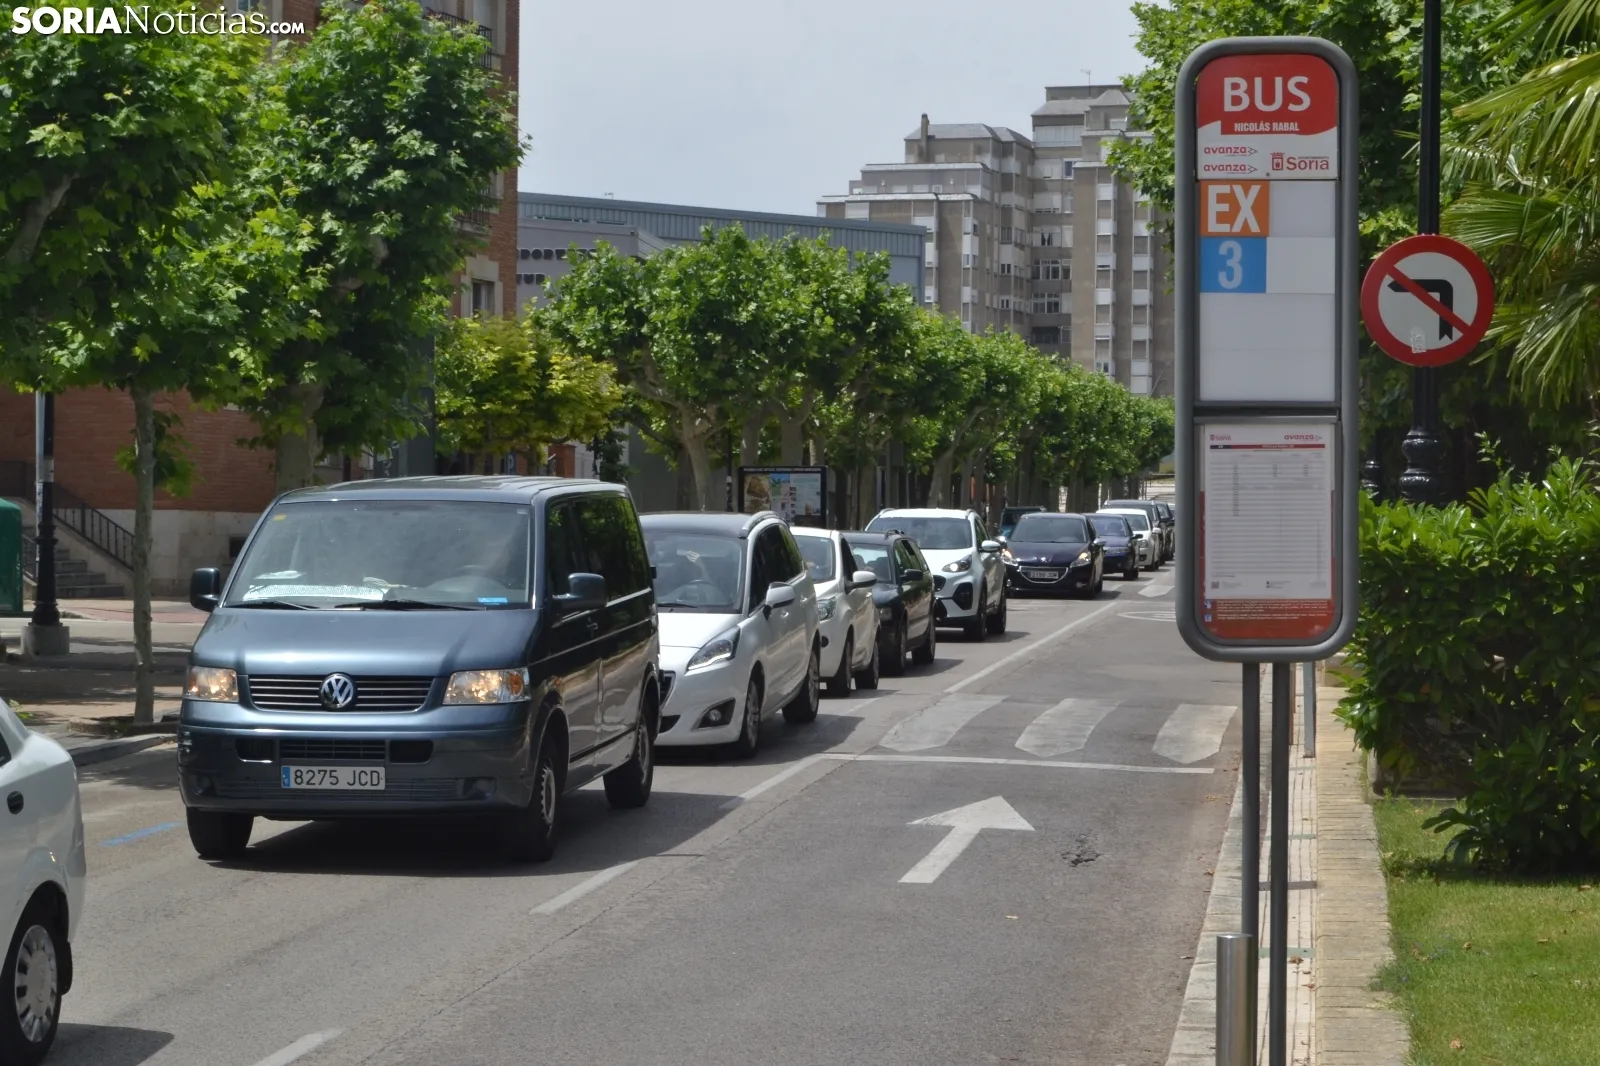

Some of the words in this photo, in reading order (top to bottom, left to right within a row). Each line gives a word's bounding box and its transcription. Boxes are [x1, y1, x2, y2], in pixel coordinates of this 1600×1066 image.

[1223, 76, 1311, 112] BUS
[1234, 121, 1270, 132] NICOLÁS
[1272, 122, 1300, 132] RABAL
[1203, 146, 1247, 154] avanza
[1203, 164, 1246, 172] avanza
[1286, 157, 1329, 171] Soria
[1207, 184, 1261, 233] EX
[1217, 240, 1244, 290] 3
[294, 769, 339, 785] 8275
[347, 770, 380, 786] JCD
